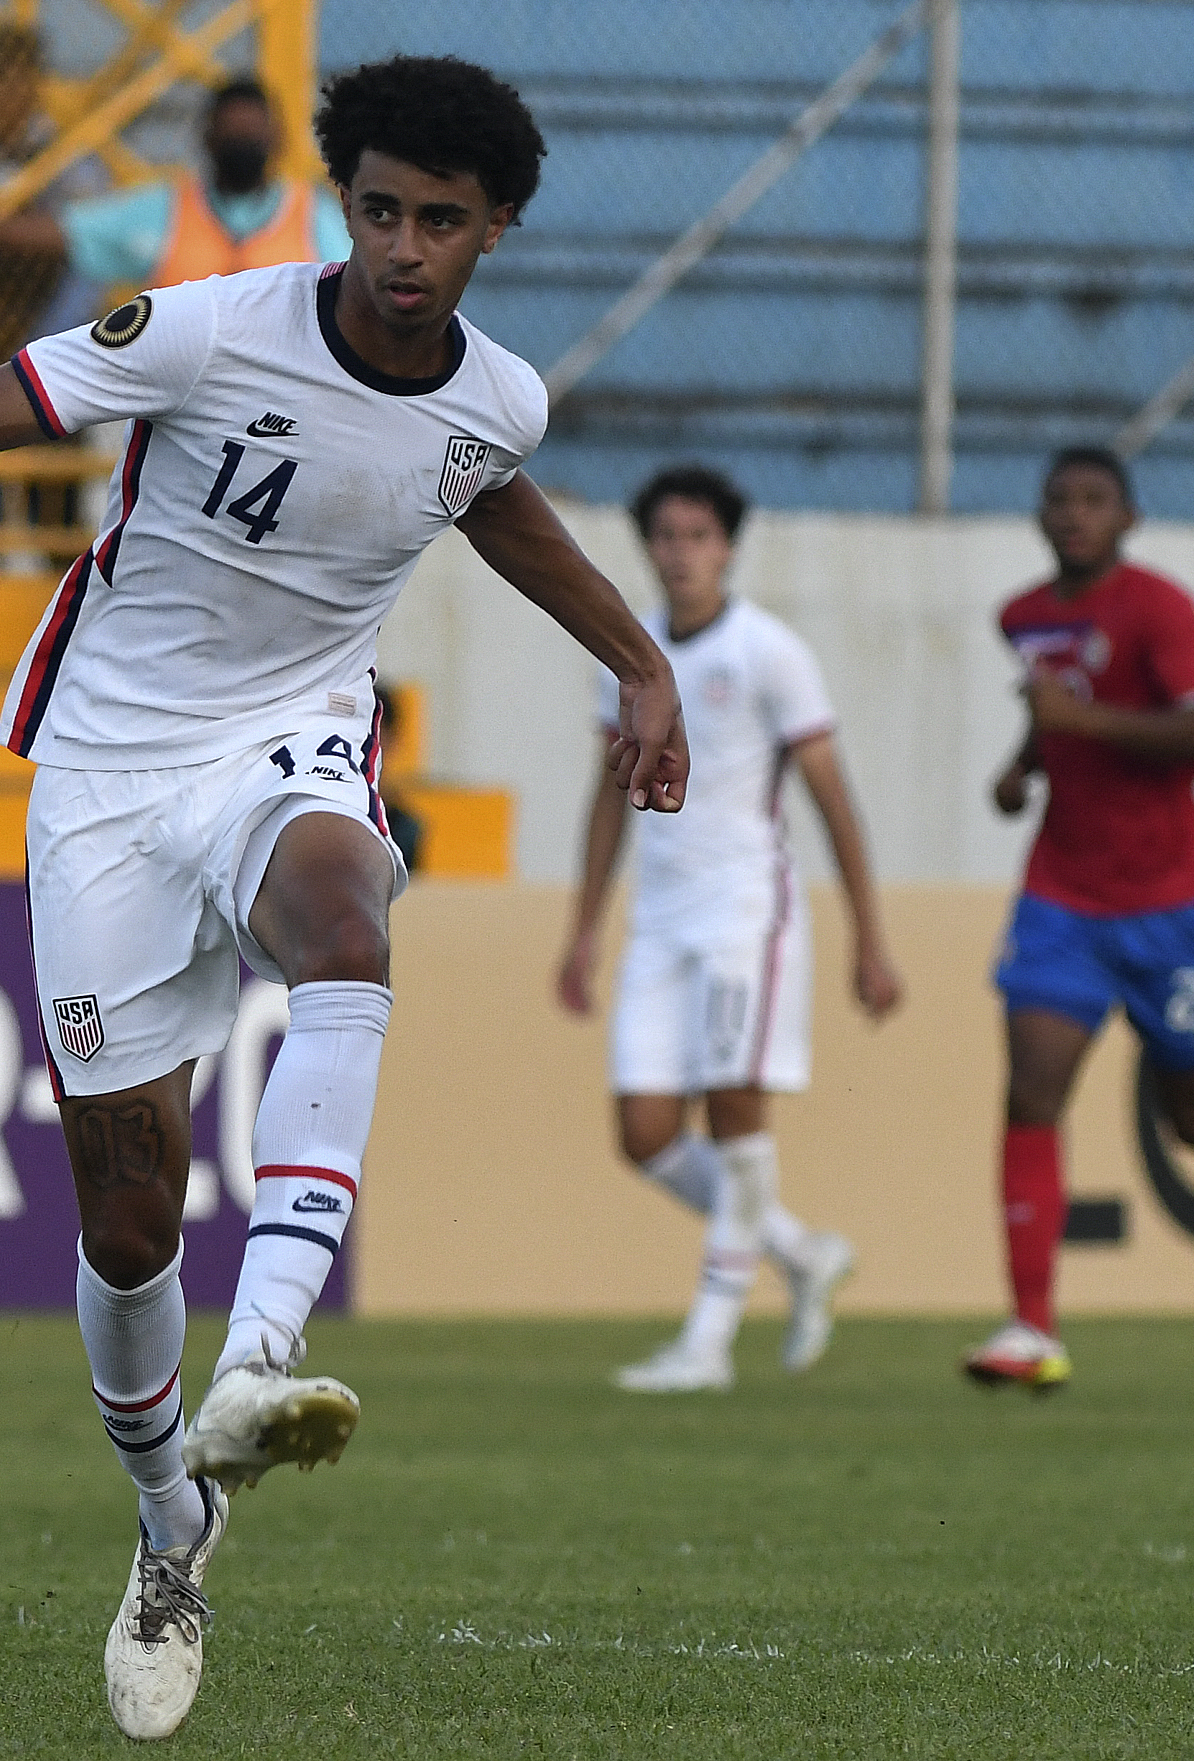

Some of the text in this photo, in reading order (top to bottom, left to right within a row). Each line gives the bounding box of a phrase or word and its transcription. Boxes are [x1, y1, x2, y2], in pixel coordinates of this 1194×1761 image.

[257, 411, 298, 433] NIKE
[451, 442, 488, 471] USA
[201, 439, 298, 544] 14
[57, 1001, 94, 1025] USA
